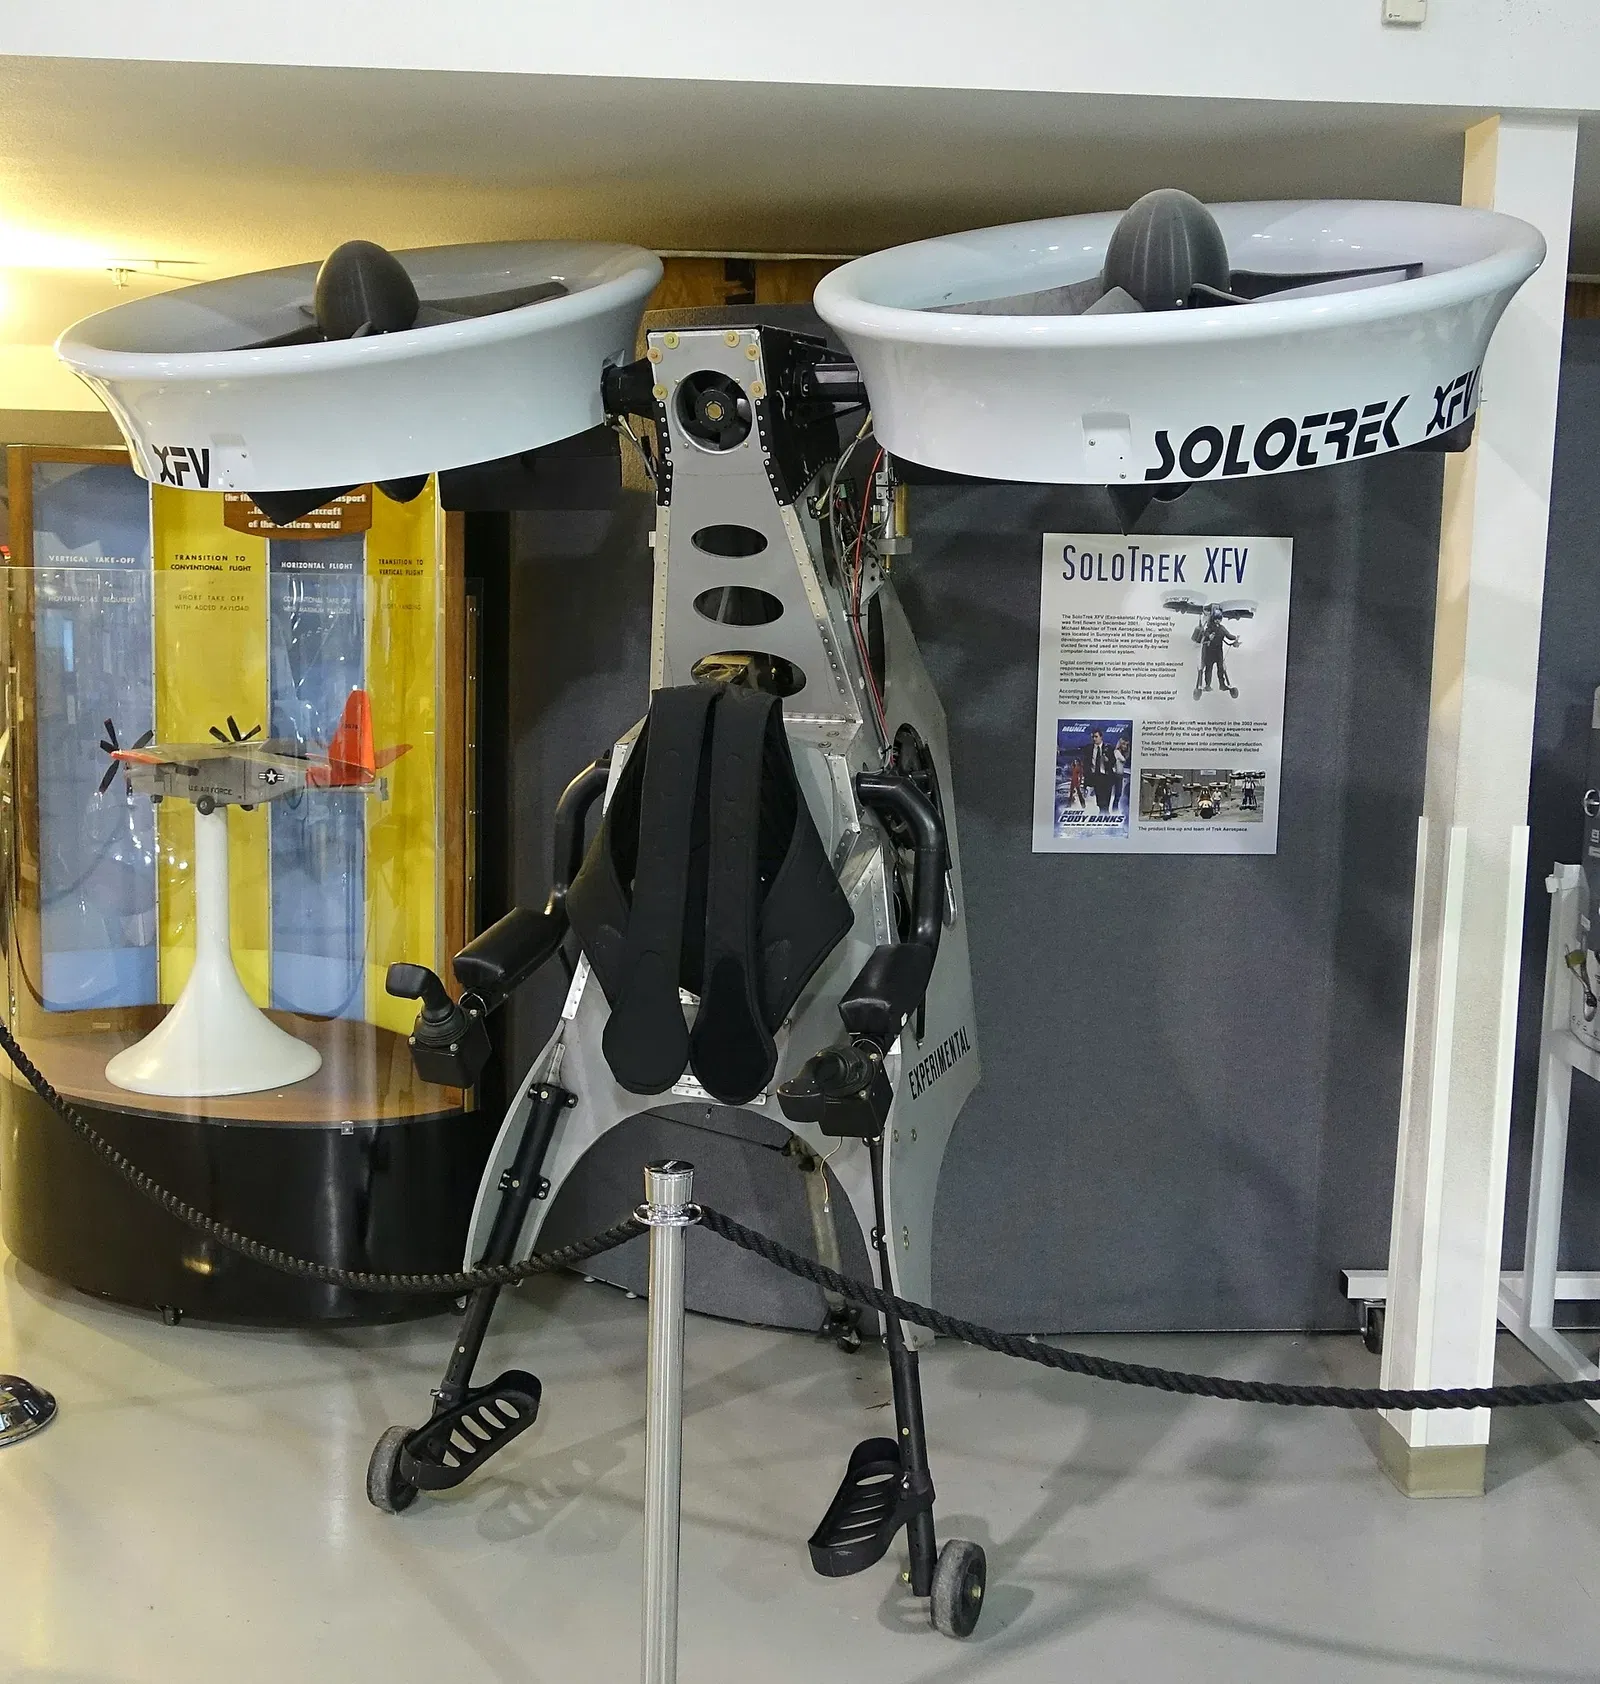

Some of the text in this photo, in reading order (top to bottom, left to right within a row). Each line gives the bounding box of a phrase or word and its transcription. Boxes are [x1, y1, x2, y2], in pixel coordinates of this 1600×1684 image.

[1144, 365, 1480, 481] SOLOTREK XFV
[151, 444, 210, 488] XFV
[248, 520, 258, 528] of
[260, 520, 273, 528] the
[314, 519, 341, 529] world
[48, 555, 136, 564] VERTICAL TAKE-OFF
[174, 554, 228, 562] TRANSITION
[281, 561, 353, 570] HORIZONTAL FLIGHT
[1203, 547, 1249, 583] XFV
[908, 1025, 971, 1100] EXPERIMENTAL
